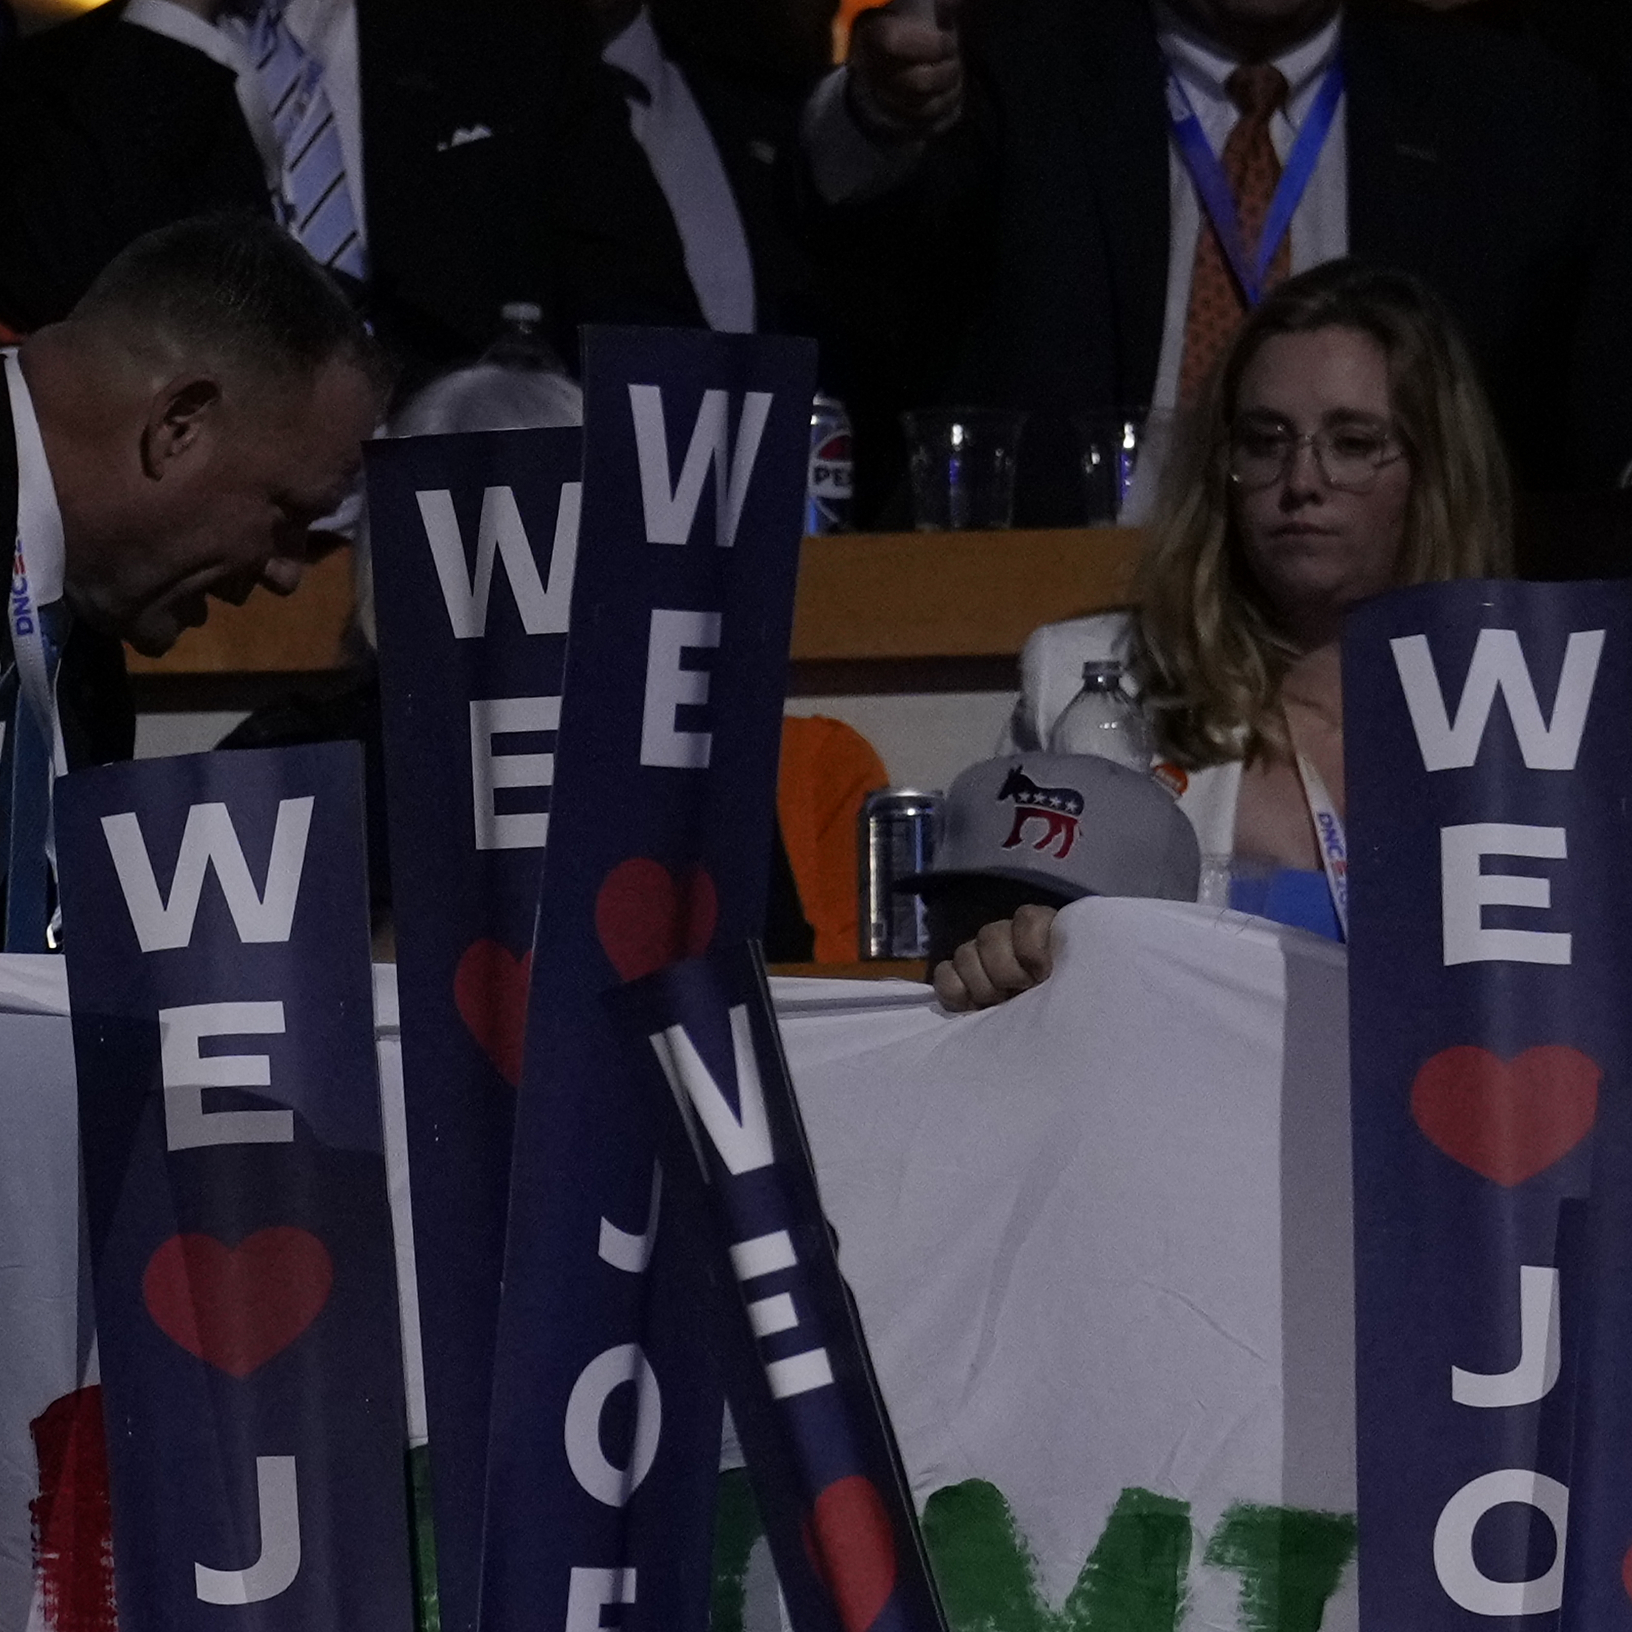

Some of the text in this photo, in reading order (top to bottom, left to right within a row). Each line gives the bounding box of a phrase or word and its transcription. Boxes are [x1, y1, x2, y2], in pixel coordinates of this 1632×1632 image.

[628, 385, 774, 770] WE
[101, 795, 315, 1152] WE
[1389, 628, 1606, 967] WE
